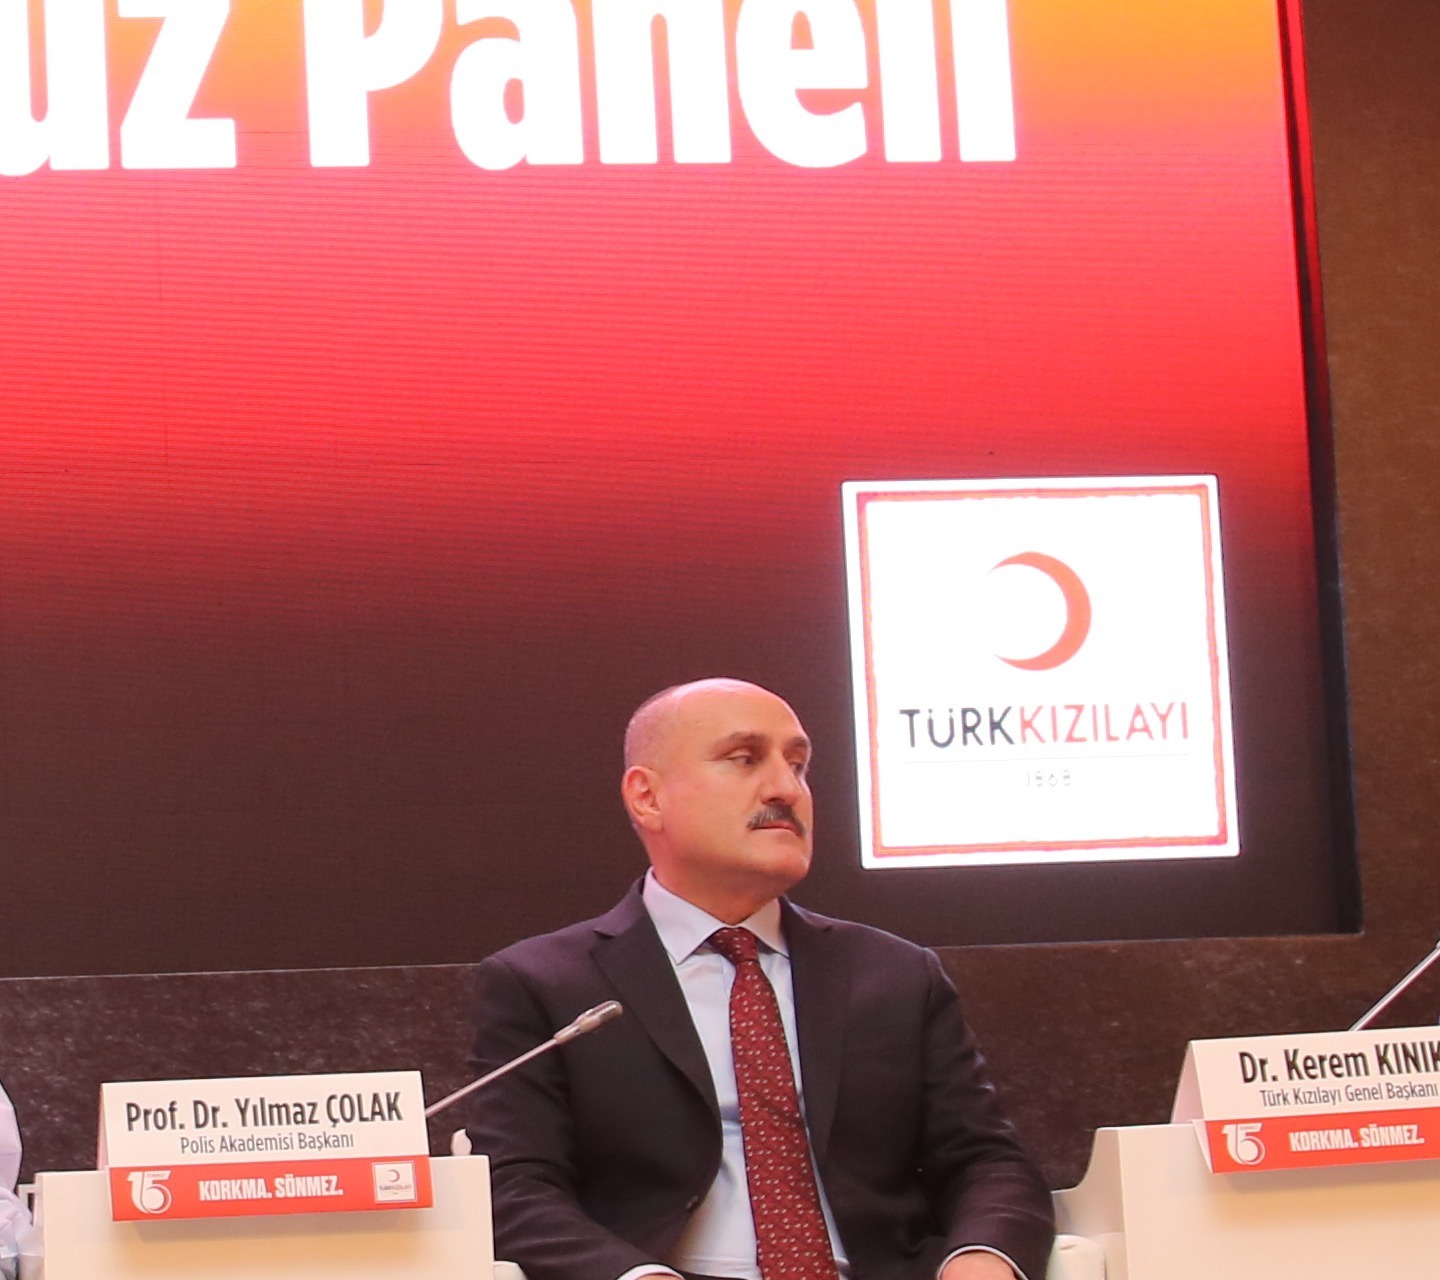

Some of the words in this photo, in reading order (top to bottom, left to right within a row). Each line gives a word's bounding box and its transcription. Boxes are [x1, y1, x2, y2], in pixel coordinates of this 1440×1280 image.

[900, 701, 1189, 749] TÜRKKIZILAYI
[1239, 1051, 1278, 1083] Dr.
[1284, 1048, 1370, 1080] Kerem
[1260, 1088, 1291, 1107] Türk
[1293, 1086, 1342, 1106] Kızılayı
[1345, 1083, 1383, 1102] Genel
[1387, 1081, 1439, 1102] Başkanı
[126, 1101, 186, 1132] Prof.
[193, 1100, 228, 1130] Dr.
[235, 1097, 320, 1128] Yılmaz
[326, 1092, 404, 1128] ÇOLAK
[180, 1136, 216, 1155] Polis
[219, 1133, 294, 1153] Akademisi
[299, 1131, 354, 1153] Başkanı
[1288, 1130, 1358, 1152] KORKMA.
[1360, 1124, 1425, 1147] SÖNMEZ.
[199, 1178, 273, 1201] KORKMA.
[275, 1175, 344, 1198] SÖNMEZ.
